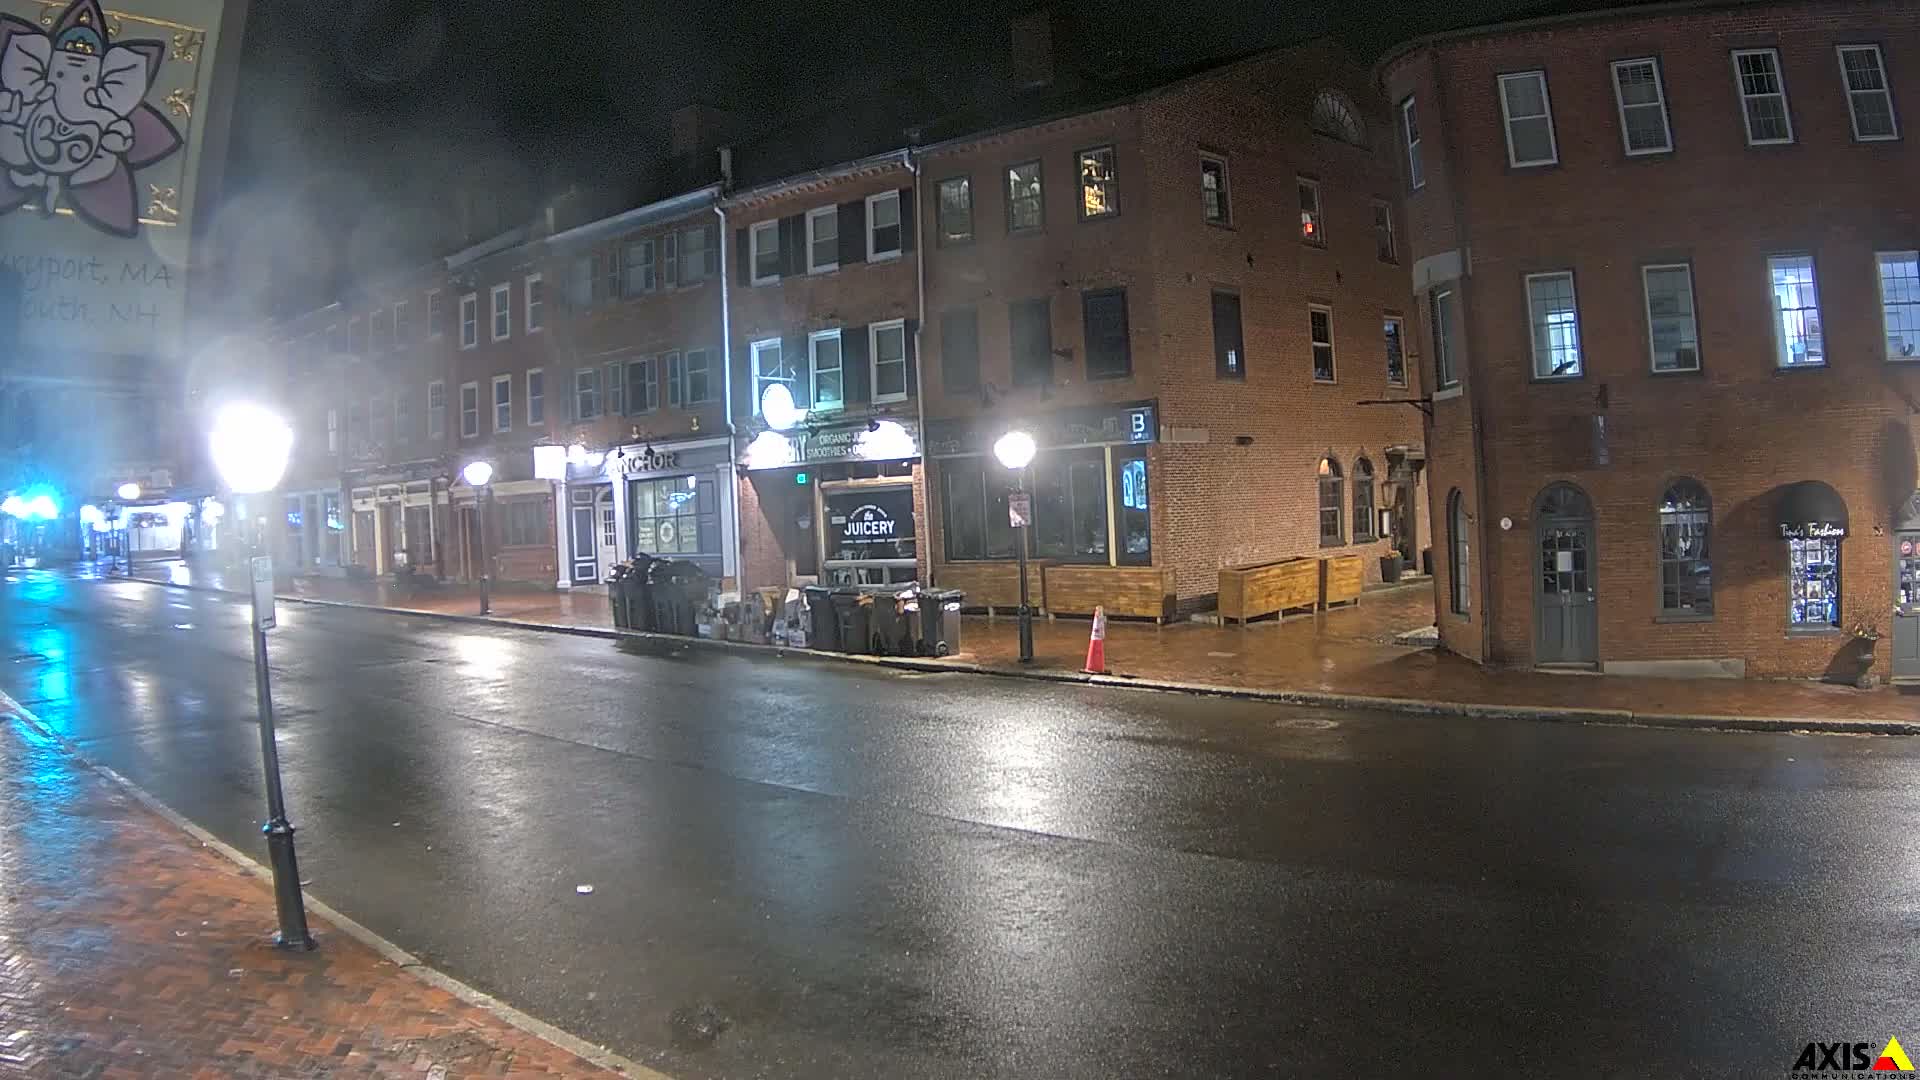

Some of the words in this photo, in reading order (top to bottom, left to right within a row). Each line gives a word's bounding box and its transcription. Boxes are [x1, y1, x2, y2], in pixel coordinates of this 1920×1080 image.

[120, 262, 174, 289] MA
[110, 303, 161, 328] NH
[1131, 412, 1145, 432] B
[819, 432, 851, 446] ORGANIC
[844, 520, 895, 536] JUICERY
